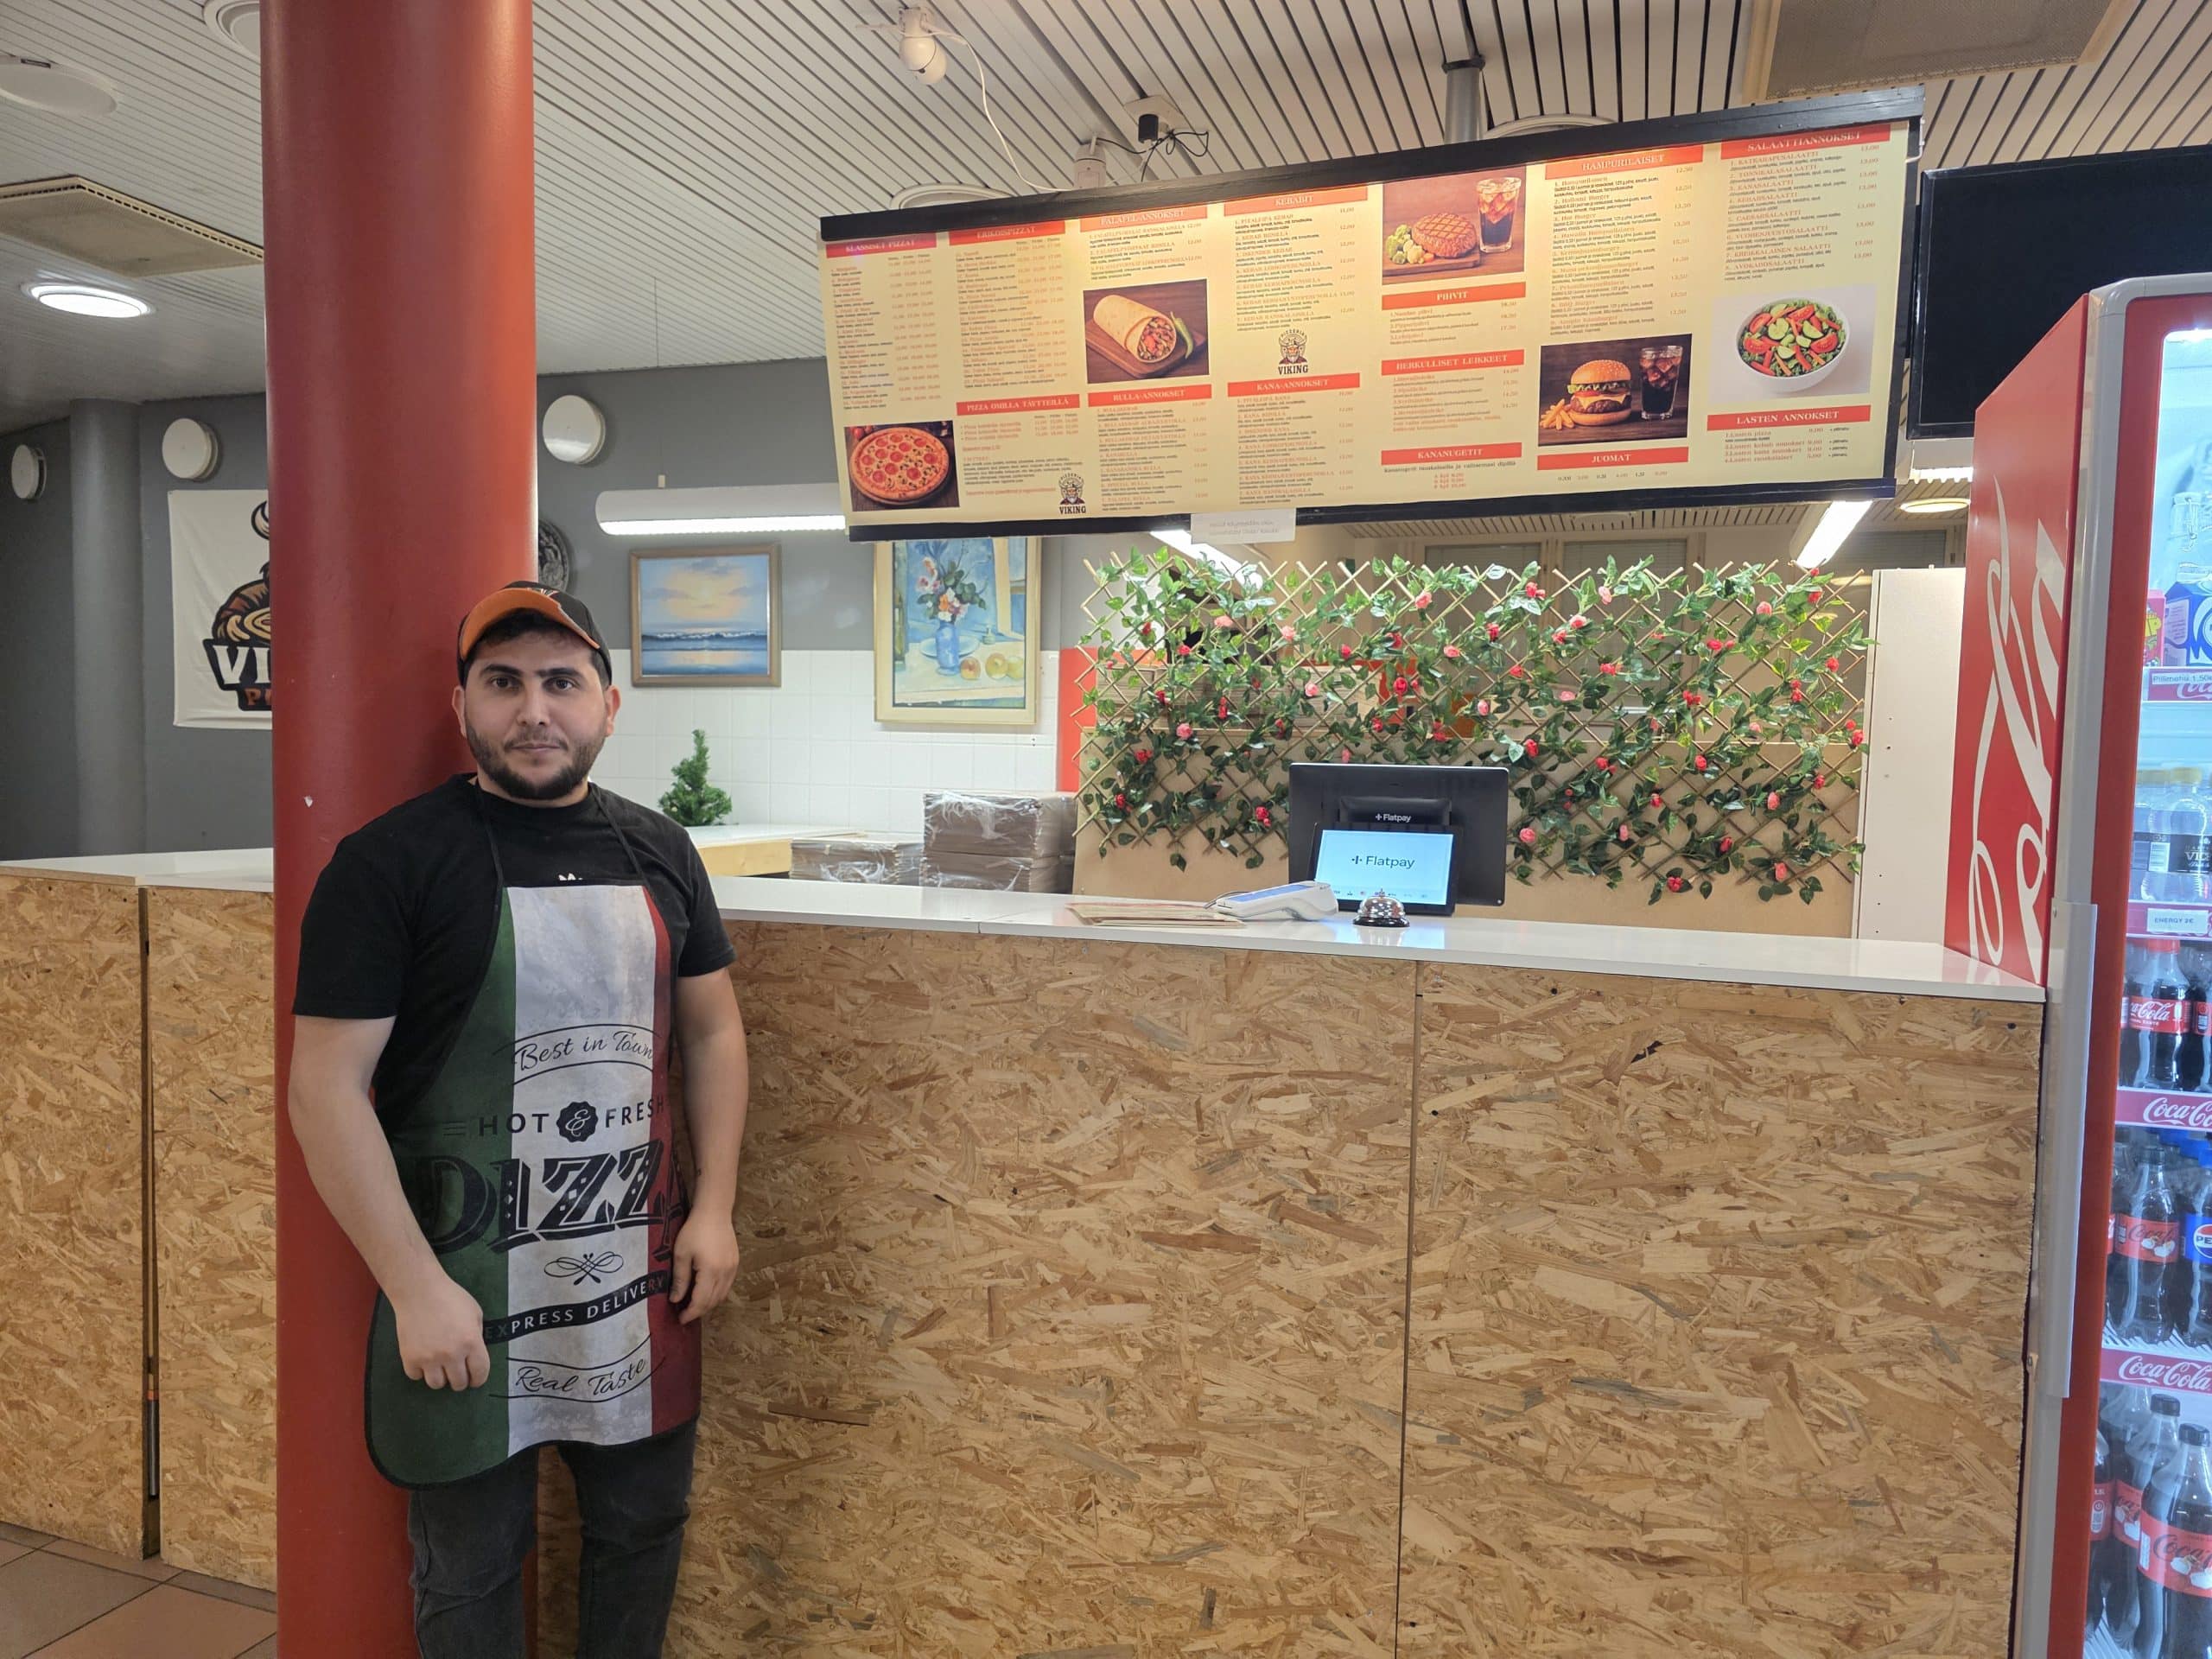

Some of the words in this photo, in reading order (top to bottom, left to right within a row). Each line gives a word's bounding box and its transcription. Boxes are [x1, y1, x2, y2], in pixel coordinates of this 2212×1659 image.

[1582, 154, 1665, 171] HAMPURILAISET
[1437, 290, 1468, 302] PIHVIT
[1278, 364, 1309, 375] VIKING
[967, 402, 988, 411] PIZZA
[1737, 415, 1778, 425] LASTEN
[1782, 410, 1840, 422] ANNOKSET
[1418, 448, 1484, 460] KANANUGETIT
[1592, 454, 1631, 463] JUOMAT
[1058, 505, 1086, 515] VIKING
[1383, 814, 1411, 823] Flatpay
[1365, 855, 1415, 869] Flatpay
[513, 1039, 574, 1071] Best
[582, 1036, 607, 1052] in
[613, 1031, 653, 1059] Town
[479, 1112, 550, 1137] HOT
[605, 1094, 664, 1128] FRESH
[587, 1279, 664, 1317] DELIVERY
[517, 1367, 579, 1393] Real
[588, 1357, 646, 1396] Taste
[2119, 1355, 2212, 1390] Coca-Cola
